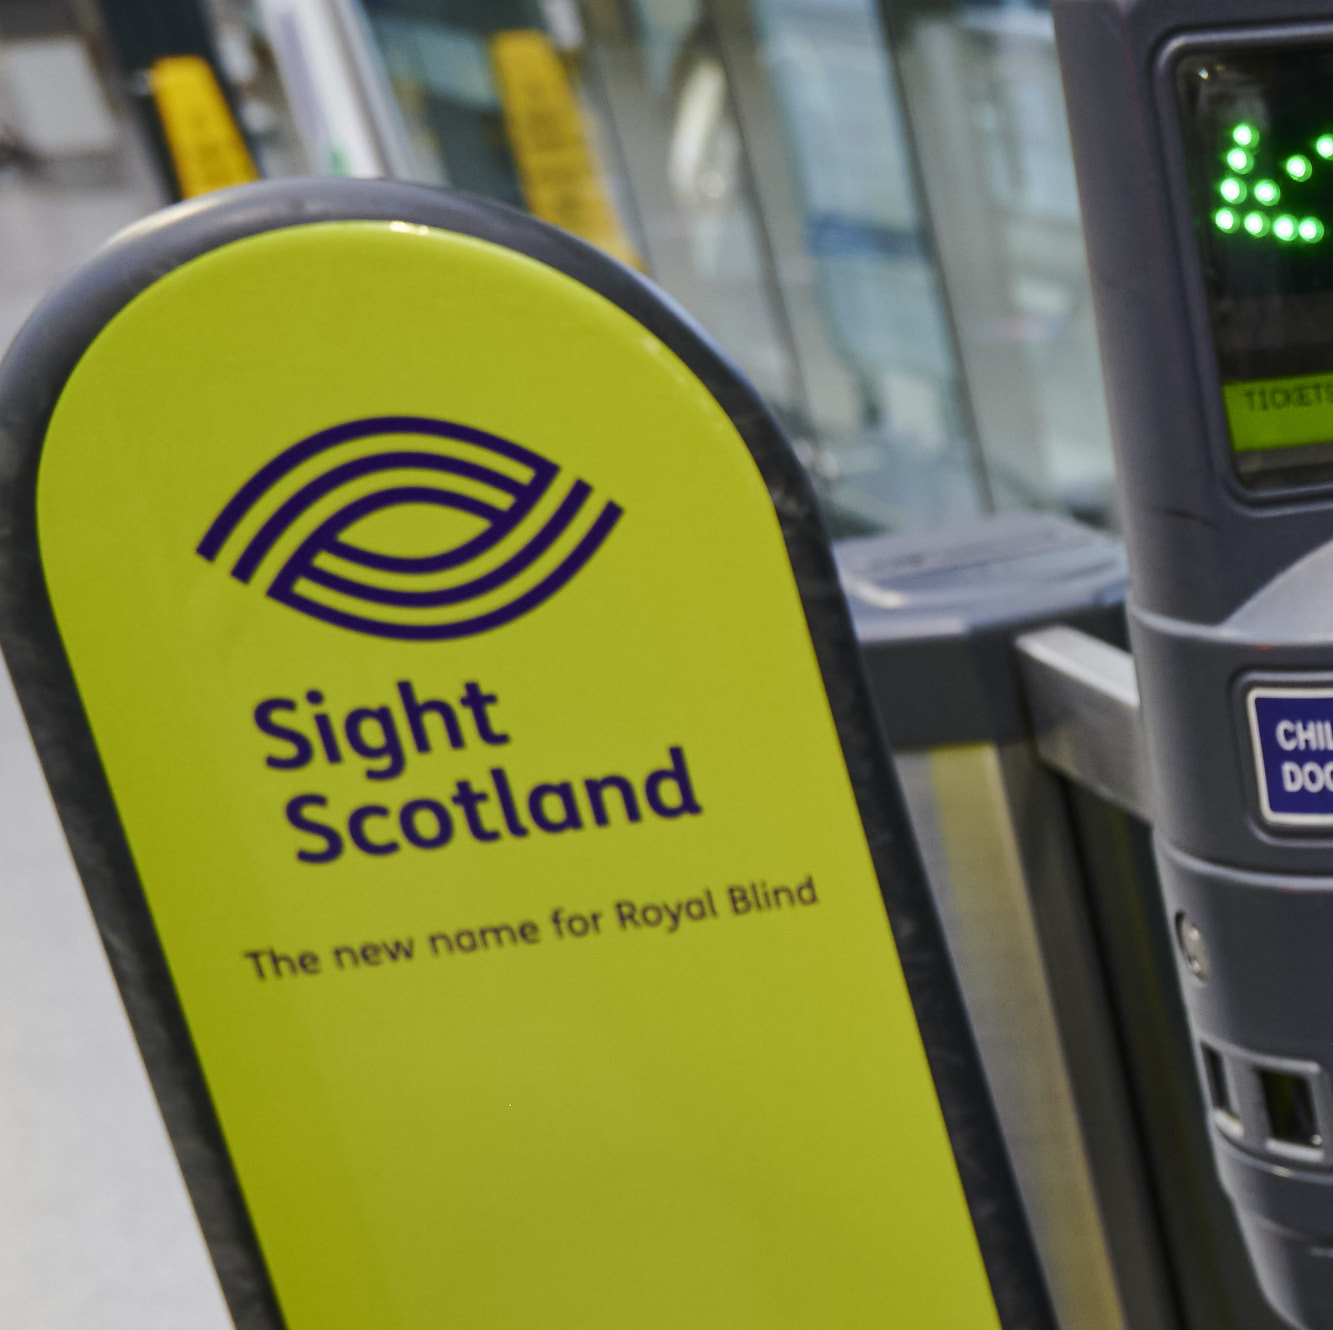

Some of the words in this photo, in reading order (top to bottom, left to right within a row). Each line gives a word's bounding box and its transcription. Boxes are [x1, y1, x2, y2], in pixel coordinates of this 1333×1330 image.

[252, 680, 511, 781] Sight
[284, 745, 704, 865] Scotland
[243, 948, 321, 982] The
[332, 935, 415, 971] new
[429, 919, 541, 958] name
[551, 906, 603, 938] for
[615, 890, 719, 934] Royal
[727, 875, 819, 917] Blind
